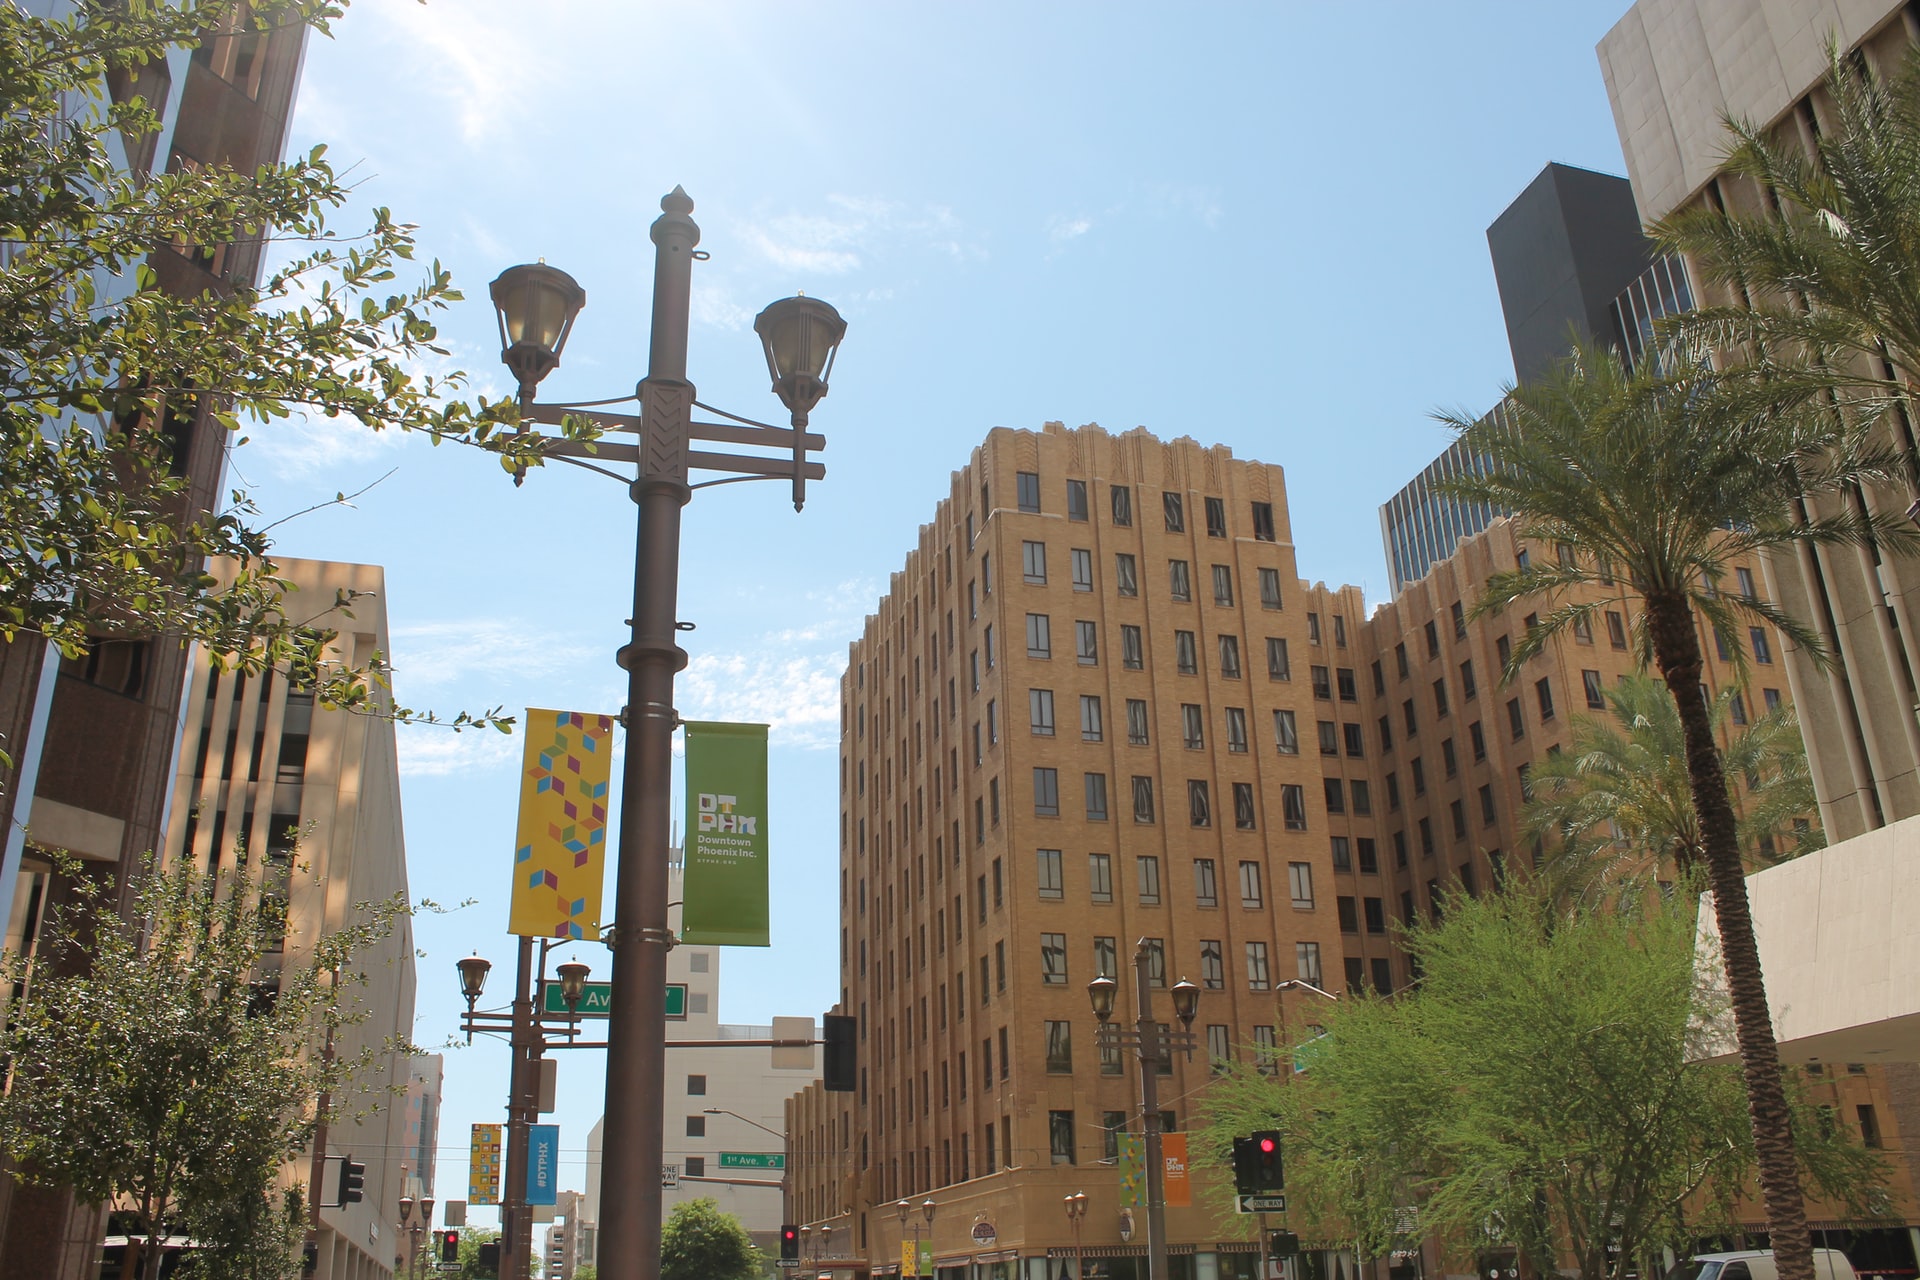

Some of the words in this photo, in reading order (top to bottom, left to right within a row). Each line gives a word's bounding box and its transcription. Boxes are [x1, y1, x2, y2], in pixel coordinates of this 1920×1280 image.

[698, 793, 737, 814] DT
[698, 812, 757, 835] PHX
[697, 834, 752, 846] Downtown
[697, 845, 738, 857] Phoenix
[739, 848, 758, 858] Inc.
[586, 991, 611, 1007] Av
[537, 1142, 549, 1188] #DTPHX
[727, 1156, 738, 1164] 1st
[739, 1156, 760, 1166] Ave.
[1253, 1200, 1266, 1208] ONE
[1268, 1199, 1282, 1208] WAY
